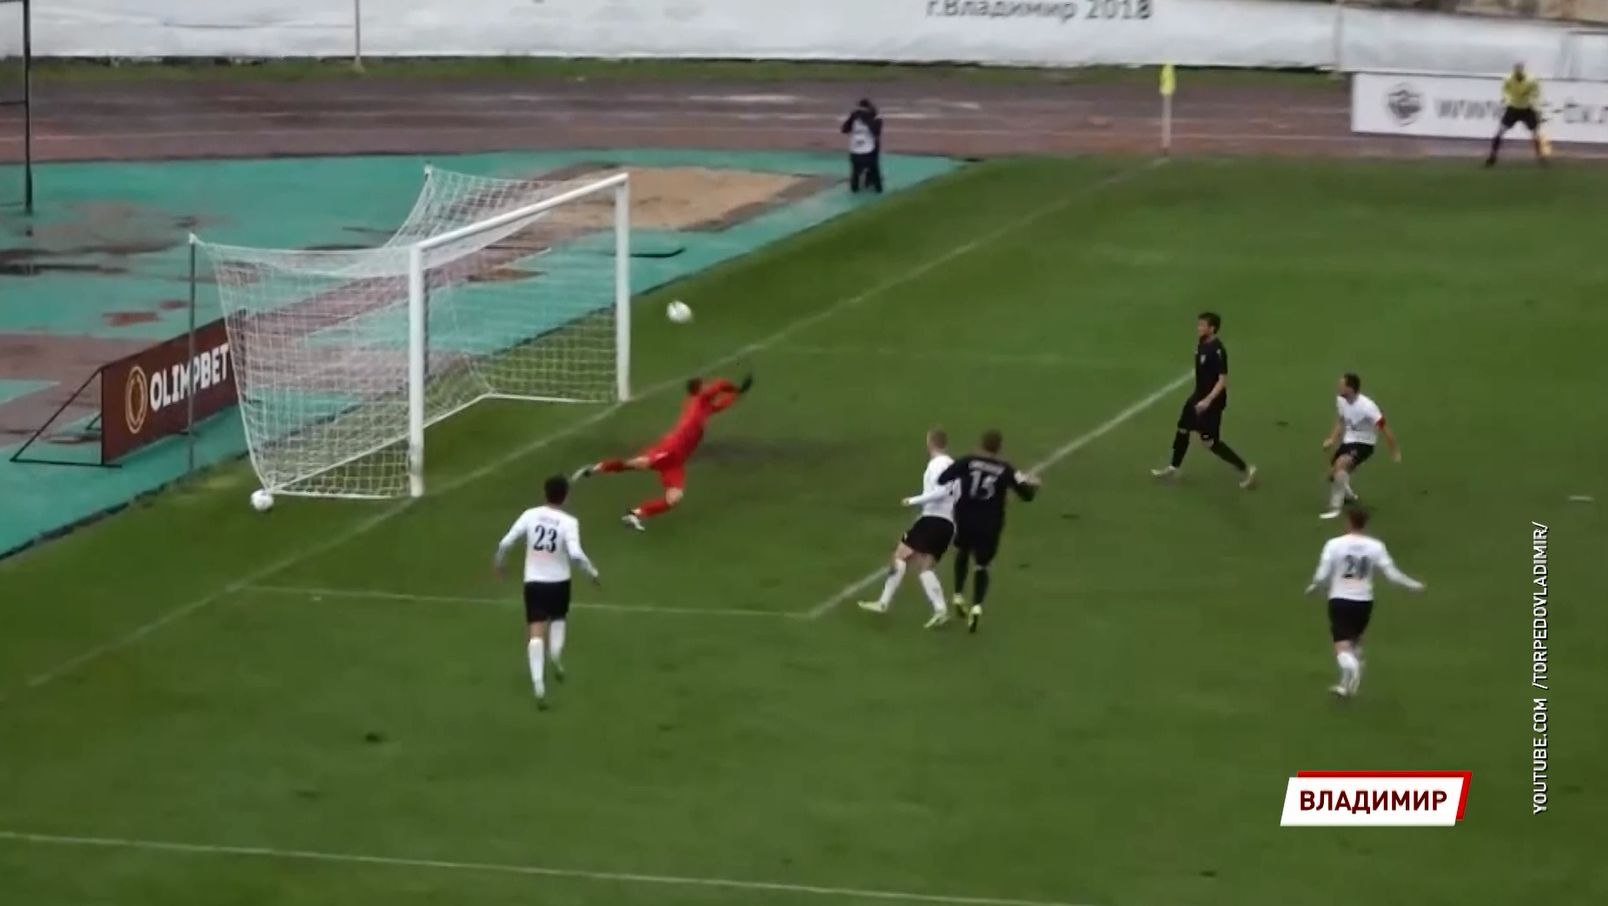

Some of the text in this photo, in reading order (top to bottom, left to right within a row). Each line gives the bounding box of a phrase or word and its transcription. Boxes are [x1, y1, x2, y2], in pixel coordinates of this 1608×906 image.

[1085, 0, 1152, 19] 2018
[150, 342, 230, 412] OLIMPBET
[969, 469, 999, 500] 15
[533, 524, 558, 553] 23
